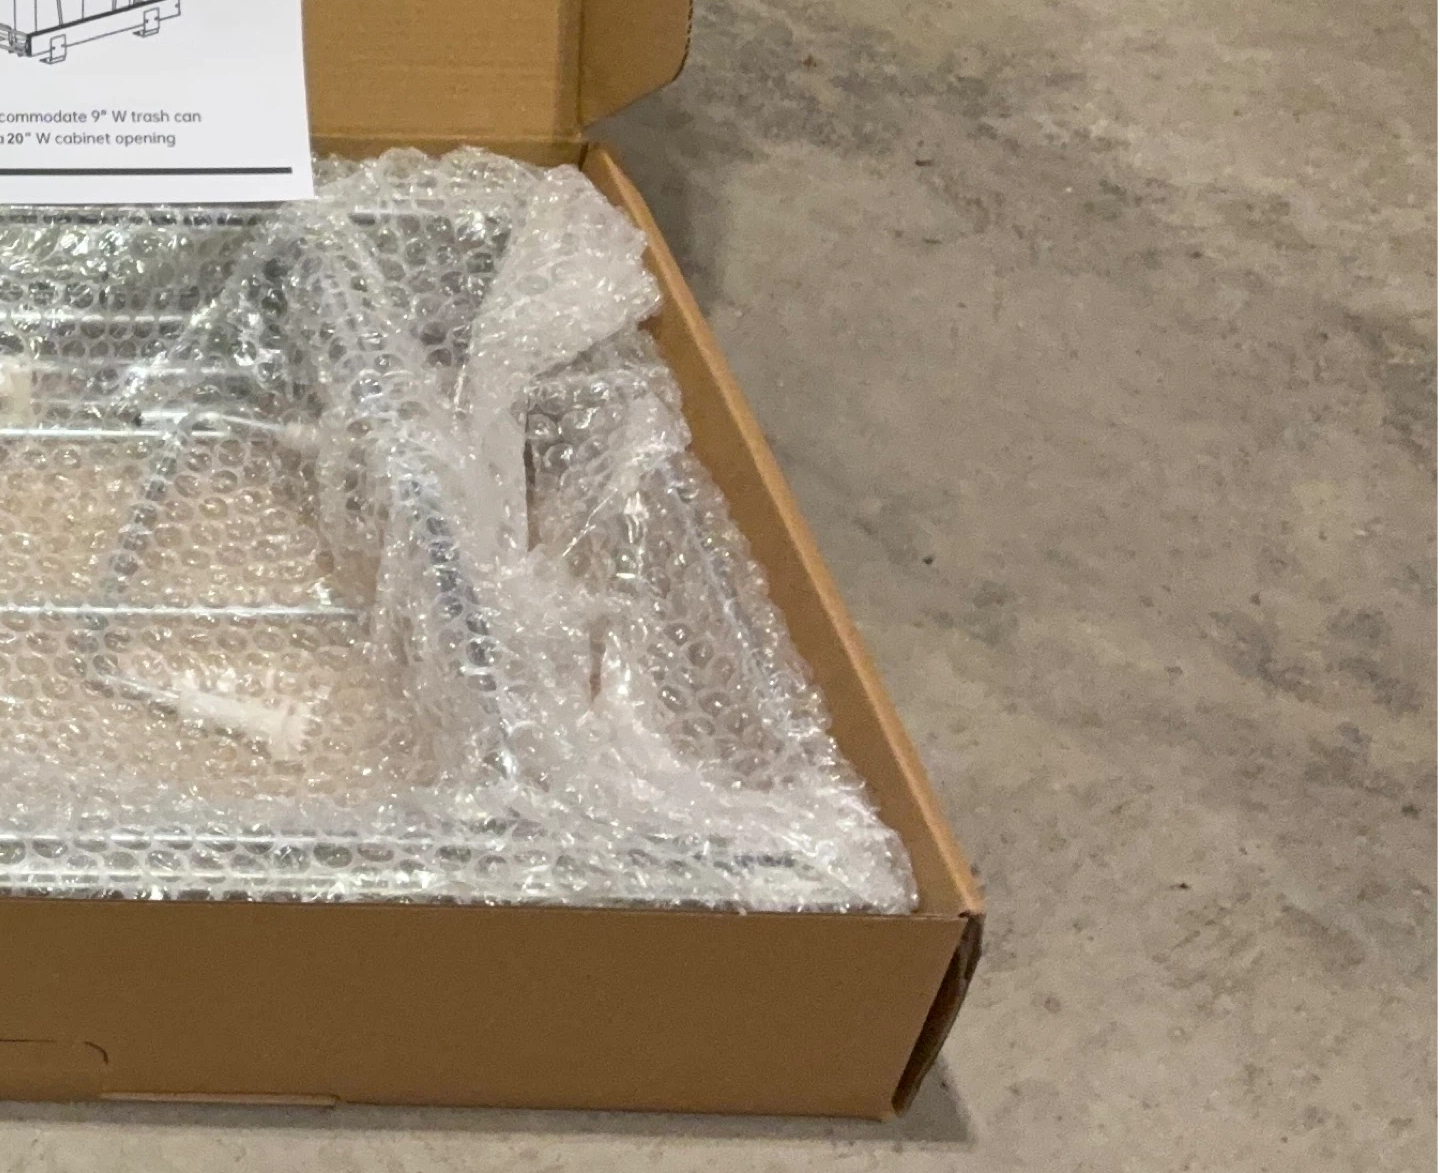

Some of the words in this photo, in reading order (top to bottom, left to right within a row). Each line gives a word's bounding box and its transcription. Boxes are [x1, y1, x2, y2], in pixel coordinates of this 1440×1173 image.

[112, 109, 127, 124] W
[131, 108, 170, 124] trash
[174, 111, 202, 124] can
[35, 131, 51, 146] W
[55, 131, 111, 146] cabinet
[115, 131, 176, 149] opening
